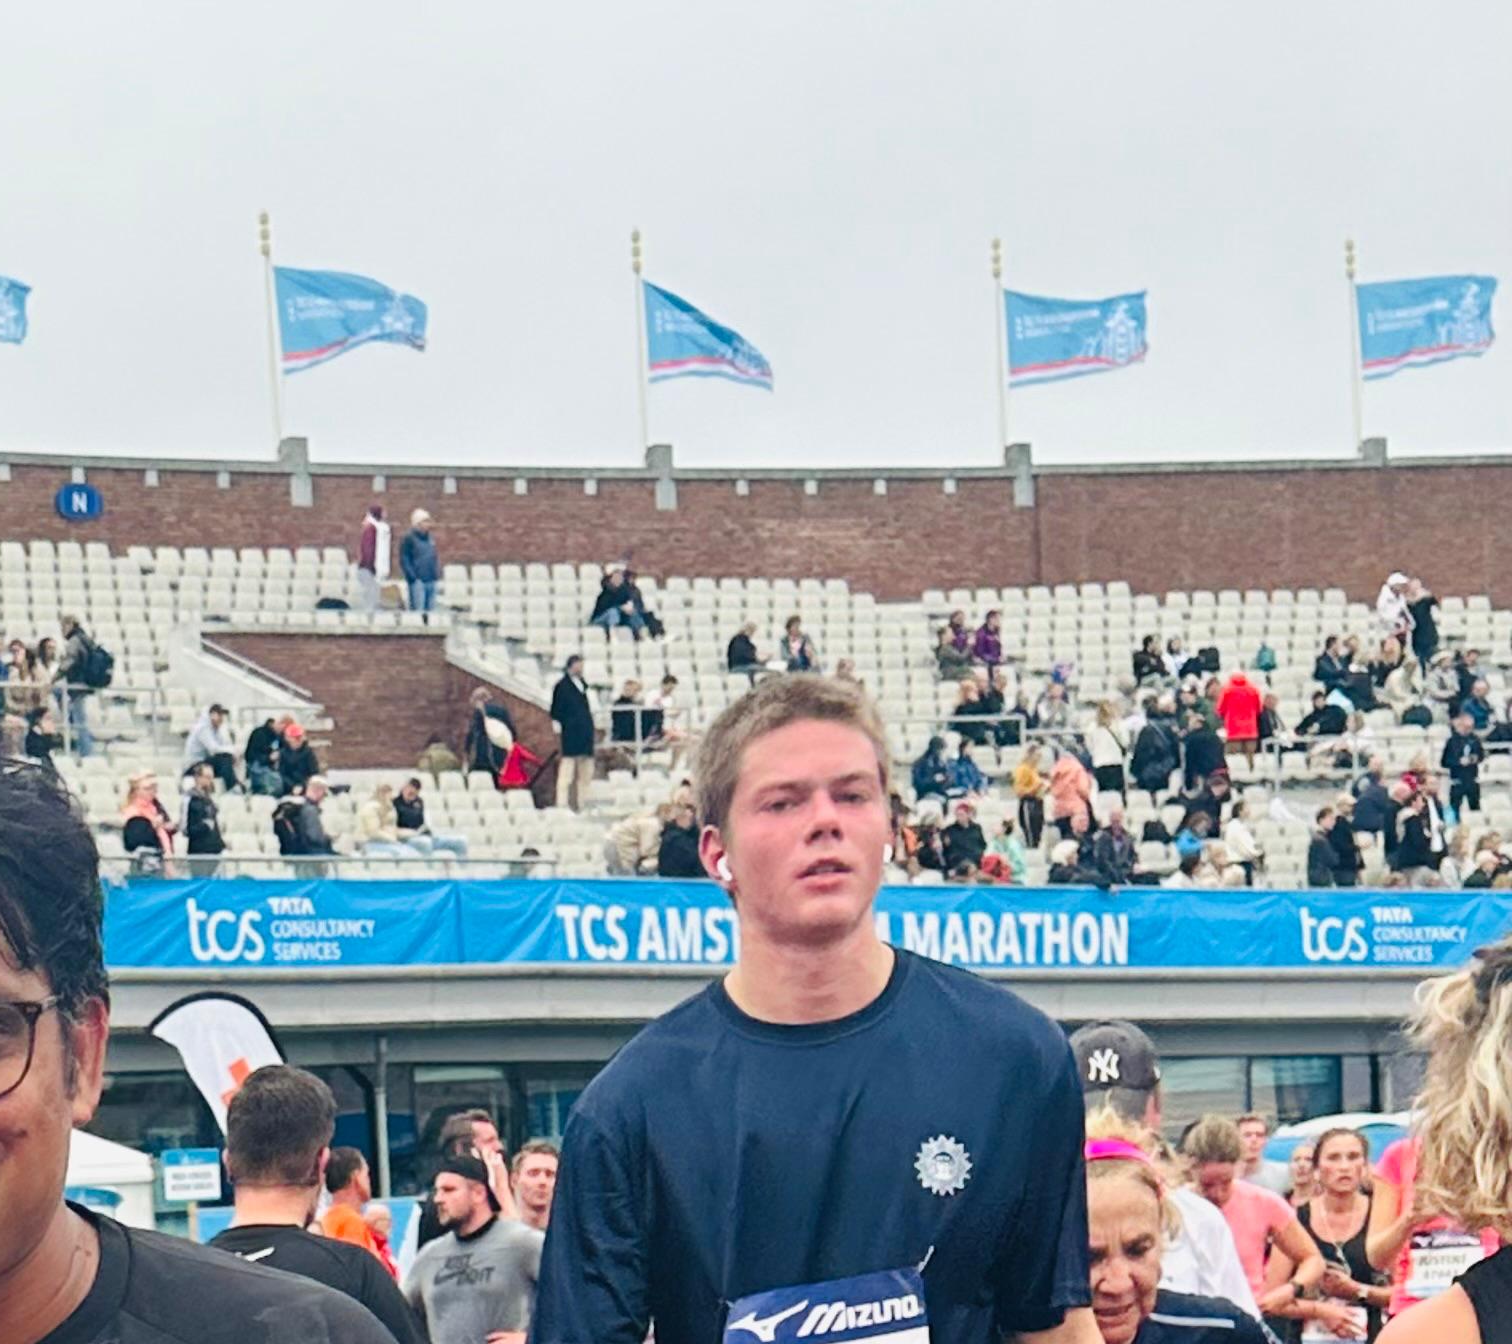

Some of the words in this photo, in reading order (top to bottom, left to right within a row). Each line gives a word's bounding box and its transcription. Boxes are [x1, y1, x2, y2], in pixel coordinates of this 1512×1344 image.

[72, 491, 88, 513] N
[267, 896, 315, 915] TATA
[1370, 906, 1414, 923] TATA
[186, 897, 265, 962] tcs
[270, 919, 375, 939] CONSULTANCY
[555, 904, 629, 962] TCS
[902, 911, 1129, 966] MARATHON
[1299, 906, 1369, 962] tcs
[1372, 925, 1468, 944] CONSULTANCY
[272, 941, 342, 961] SERVICES
[1373, 944, 1434, 963] SERVICES
[1087, 1048, 1120, 1082] NY
